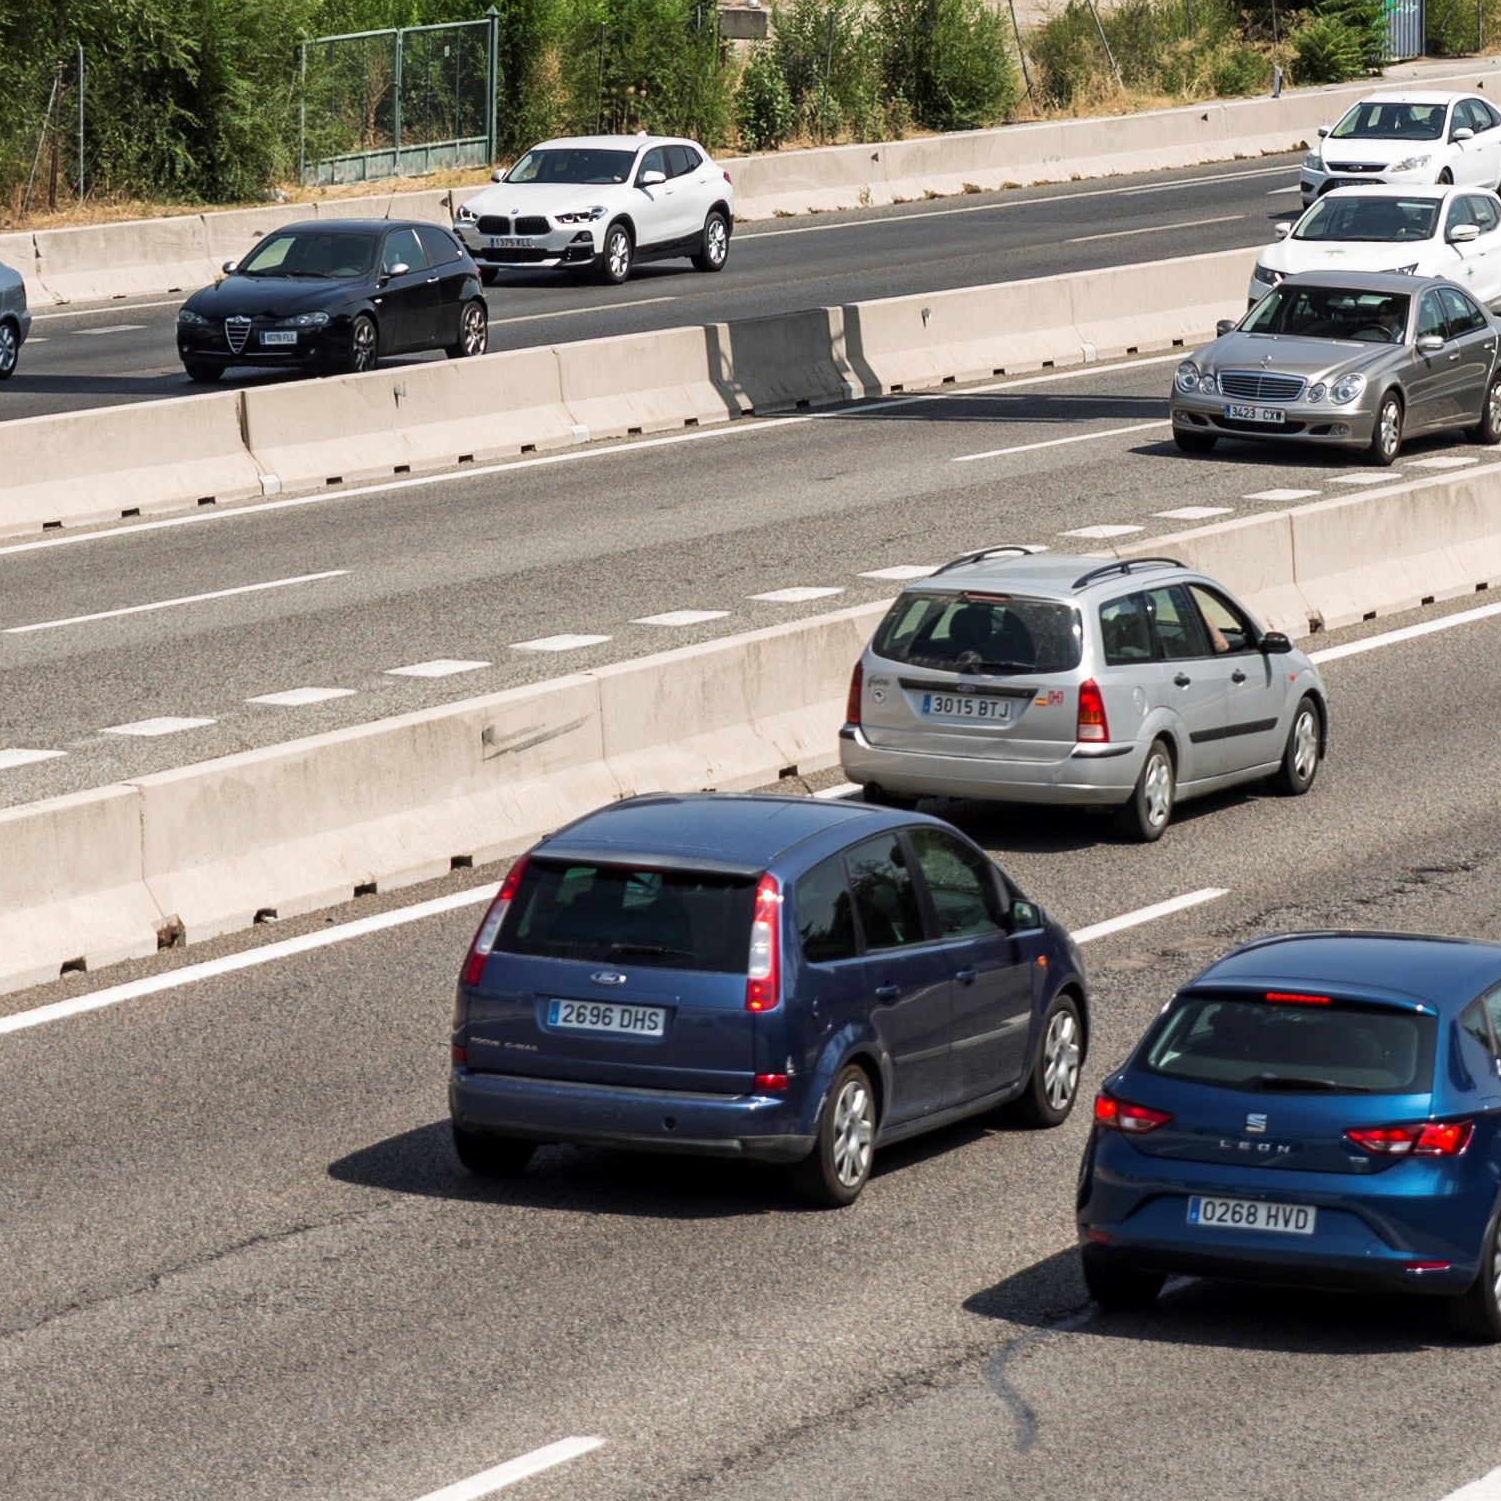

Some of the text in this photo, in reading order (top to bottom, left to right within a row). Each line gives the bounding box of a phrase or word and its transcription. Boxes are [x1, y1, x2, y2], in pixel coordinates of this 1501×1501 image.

[1231, 405, 1256, 419] 3423
[934, 696, 1010, 718] 3015 BTJ
[561, 1003, 660, 1031] 2696 DHS
[1202, 1200, 1309, 1231] 0268 HVD
